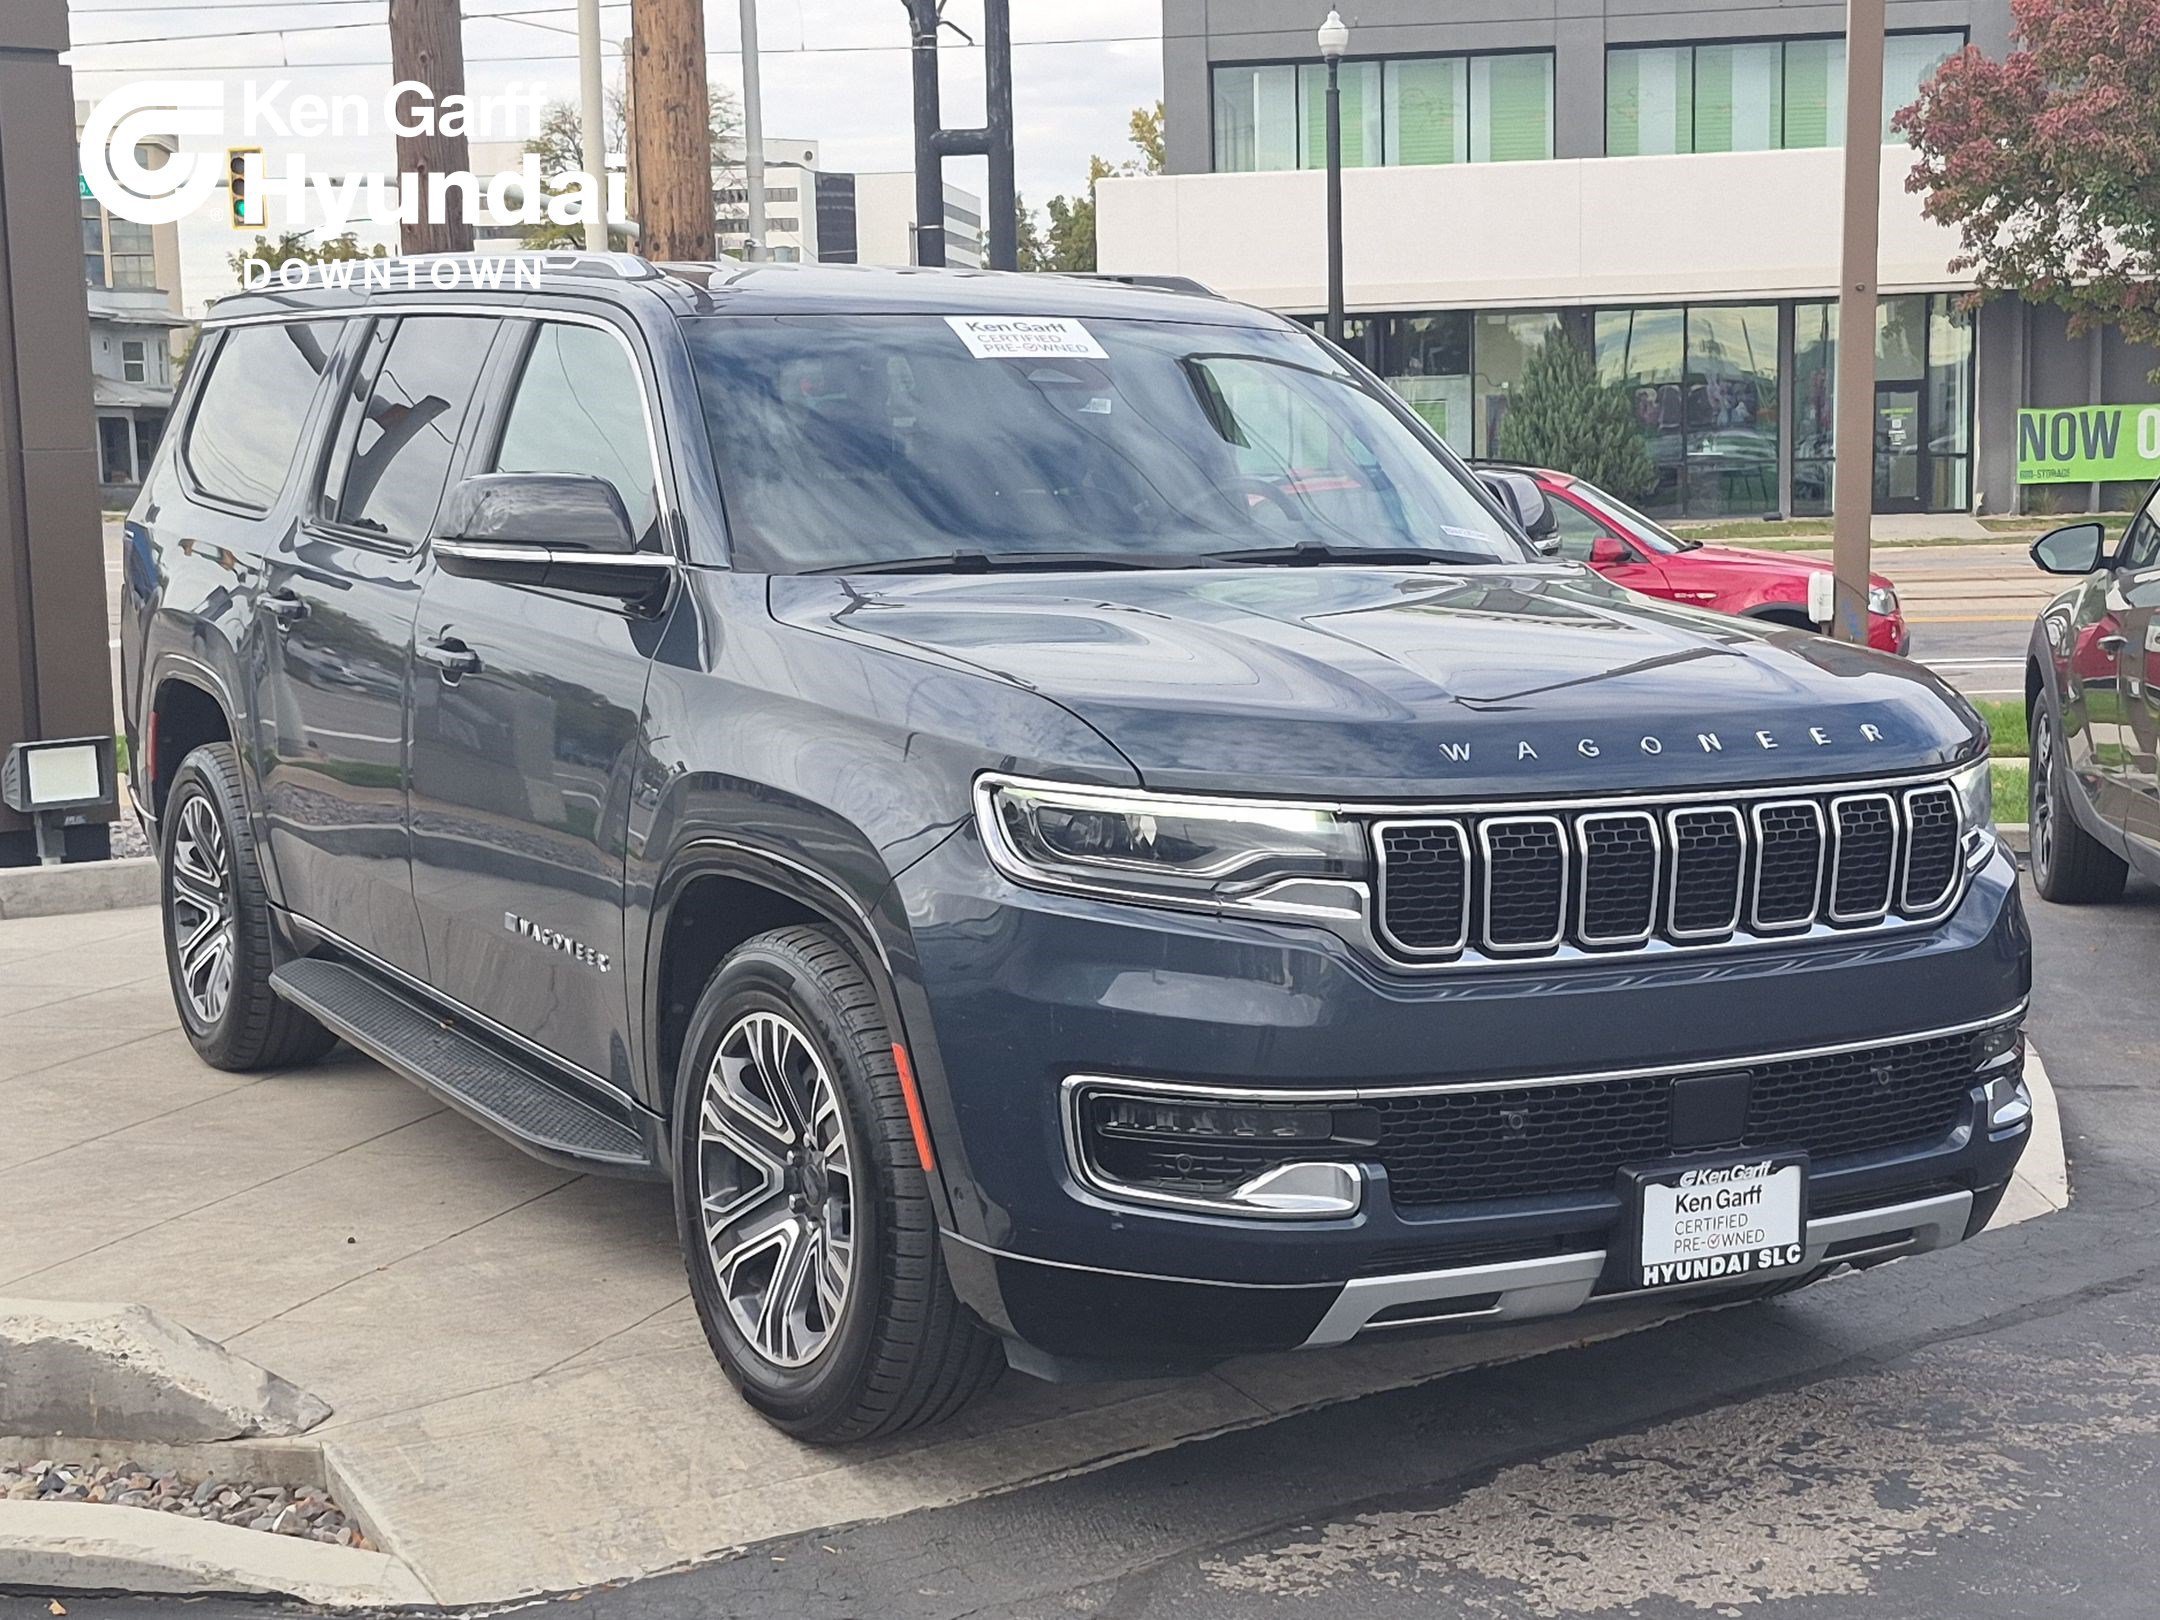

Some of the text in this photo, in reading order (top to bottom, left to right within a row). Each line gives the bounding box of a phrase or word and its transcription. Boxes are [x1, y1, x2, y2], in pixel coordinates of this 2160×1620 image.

[965, 321, 1012, 332] Ken
[977, 334, 1062, 343] CERTIFIED
[2019, 410, 2122, 462] NOW
[1439, 723, 1885, 762] WAGONEER
[1695, 1166, 1731, 1185] Ken
[1674, 1184, 1763, 1215] Ken Garff
[1674, 1213, 1749, 1236] CERTIFIED
[1642, 1244, 1801, 1287] HYUNDAI SLC
